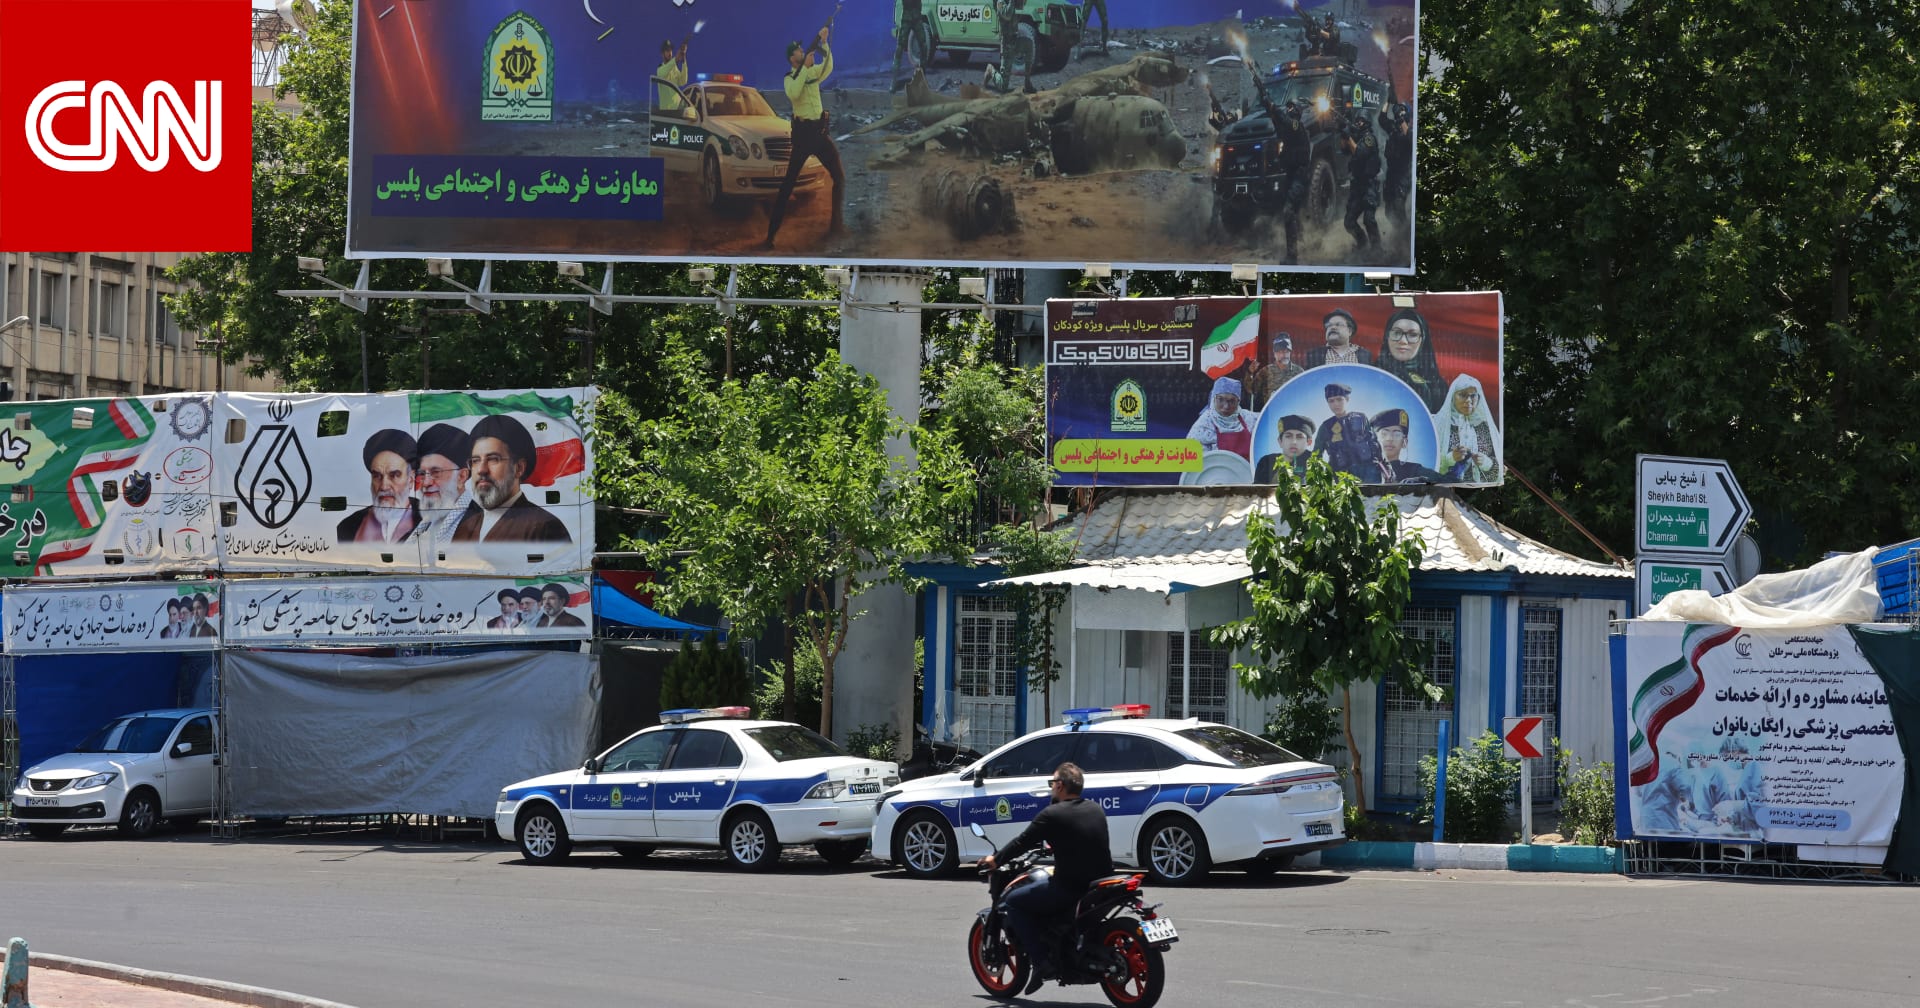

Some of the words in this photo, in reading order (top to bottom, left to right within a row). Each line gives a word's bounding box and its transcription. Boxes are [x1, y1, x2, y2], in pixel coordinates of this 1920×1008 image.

[1363, 90, 1380, 105] POLICE
[651, 127, 669, 142] پلیس
[683, 134, 704, 144] POLICE
[377, 168, 421, 202] پلیس
[425, 168, 501, 201] اجتماعی
[505, 181, 516, 202] و
[521, 168, 590, 203] فرهنگی
[595, 169, 658, 204] معاونت
[1053, 319, 1082, 332] کودکان
[1085, 321, 1103, 332] ویژه
[1105, 320, 1131, 333] پلیسی
[1133, 320, 1158, 332] سریال
[1060, 448, 1082, 465] پلیس
[1084, 448, 1121, 465] اجتماعی
[1123, 452, 1129, 465] و
[1131, 447, 1165, 465] فرهنگی
[1167, 447, 1198, 465] معاونت
[1656, 471, 1677, 485] بهایی
[1680, 471, 1697, 488] شیخ
[1647, 491, 1675, 503] Sheykh
[1677, 492, 1698, 503] Baha'i
[1698, 494, 1708, 504] St.
[1648, 510, 1674, 528] چمران
[1675, 511, 1697, 525] شهید
[271, 528, 297, 555] پزشکی
[307, 537, 330, 553] سازمان
[1647, 531, 1678, 542] Chamran
[232, 539, 253, 554] اسلامی
[1652, 571, 1690, 587] کردستان
[234, 588, 283, 626] کشور
[263, 589, 304, 638] پزشکی
[390, 602, 445, 627] خدمات
[447, 590, 496, 630] گروه
[10, 597, 38, 636] کشور
[26, 598, 51, 648] پزشکی
[103, 612, 136, 633] خدمات
[137, 599, 167, 639] گروه
[303, 607, 339, 635] جامعه
[341, 606, 391, 630] جهادی
[51, 615, 73, 646] جامعه
[74, 616, 104, 641] جهادی
[1768, 648, 1794, 658] سرطان
[1794, 648, 1808, 659] ملی
[1808, 648, 1840, 659] پژوهشگاه
[1715, 685, 1760, 702] خدمات
[1763, 685, 1791, 708] ارائه
[1805, 688, 1848, 709] مشاوره
[1792, 697, 1800, 709] و
[1712, 716, 1749, 737] بانوان
[1750, 717, 1791, 738] رایگان
[1793, 718, 1839, 740] پزشکی
[1840, 718, 1895, 740] تخصصی
[1758, 743, 1773, 751] کشور
[1831, 744, 1846, 753] توسط
[1842, 757, 1859, 766] سرطان
[1863, 758, 1874, 766] خون
[669, 786, 701, 804] پلیس
